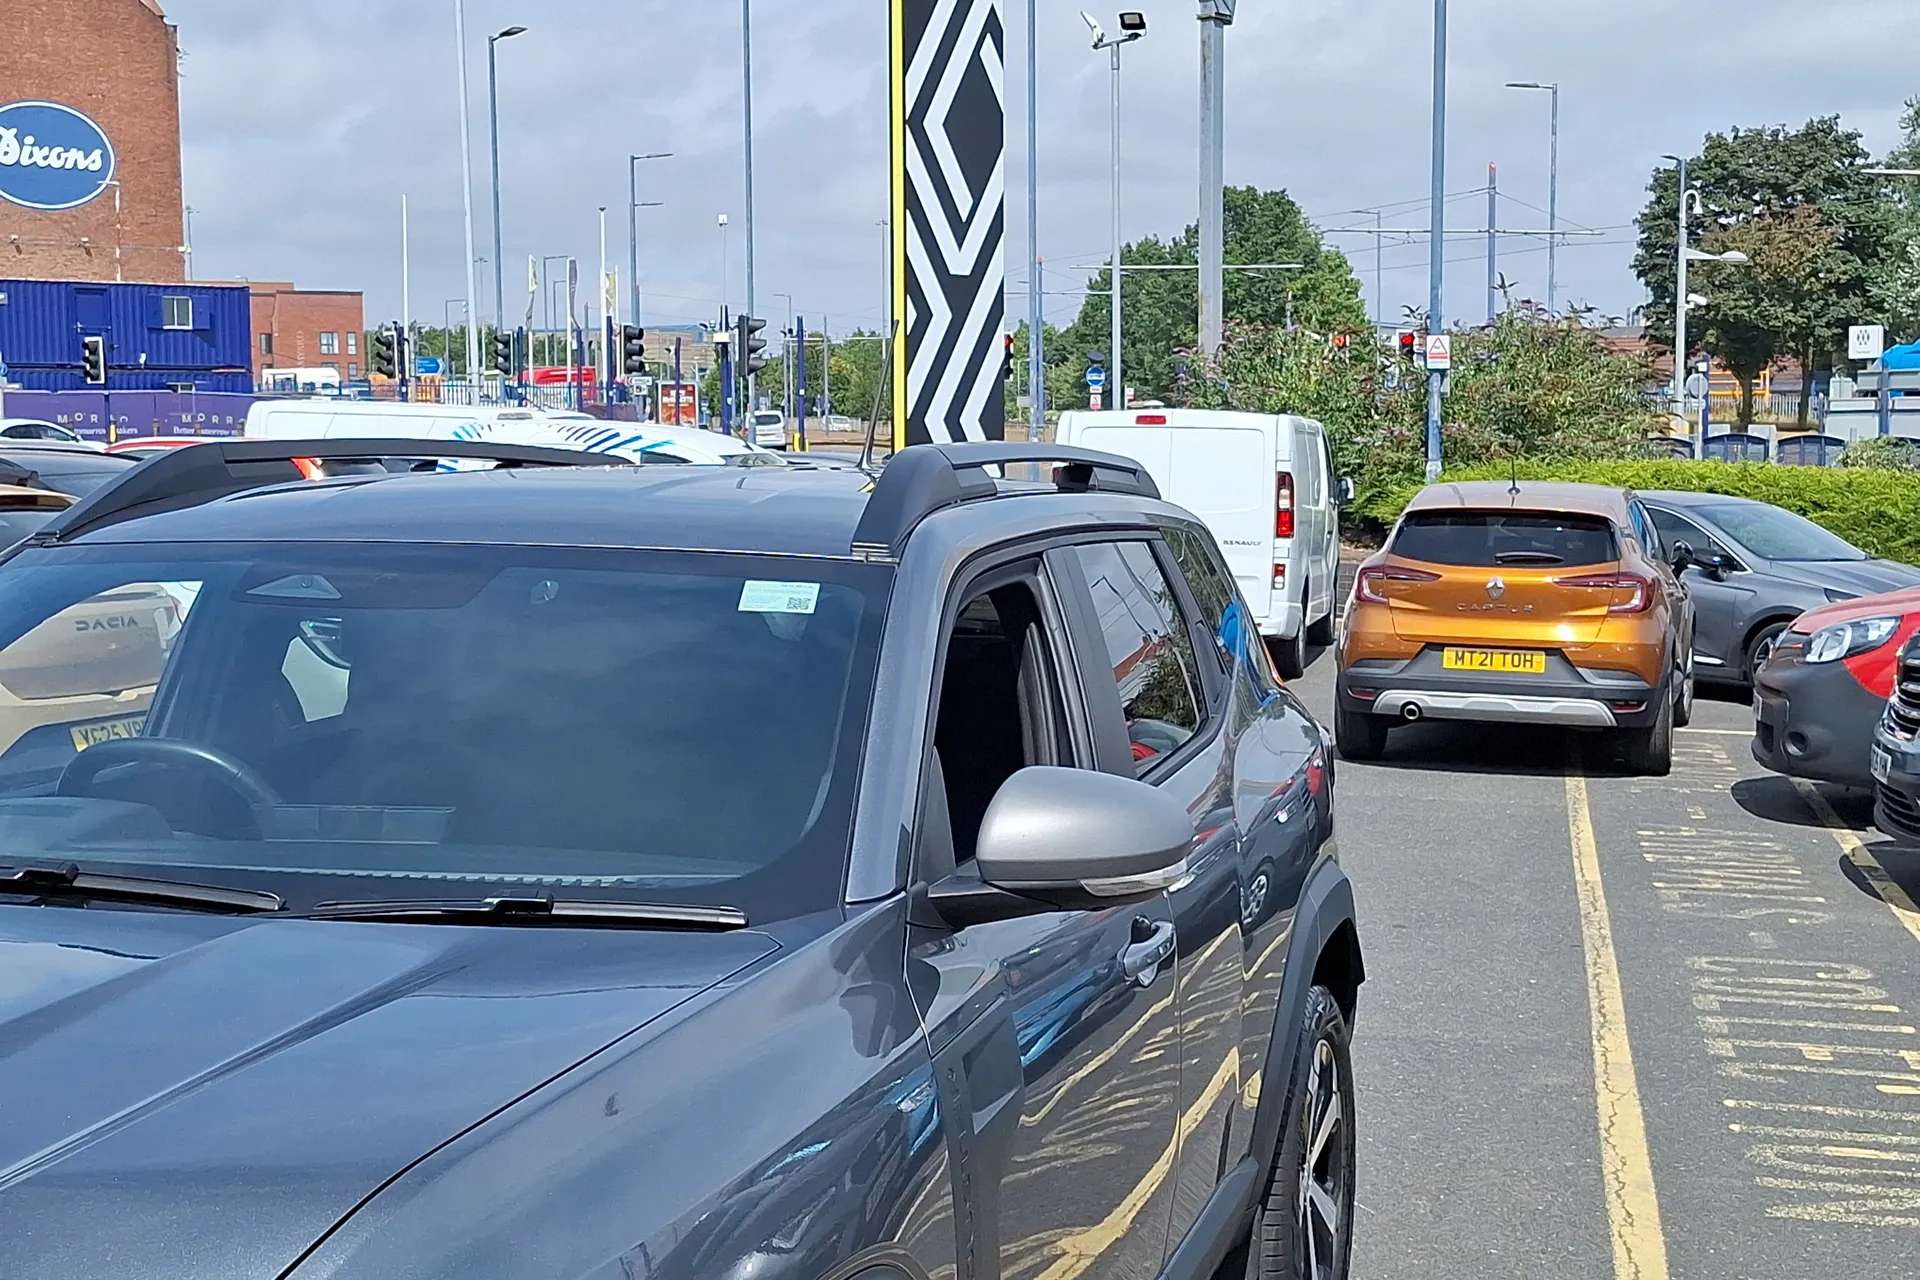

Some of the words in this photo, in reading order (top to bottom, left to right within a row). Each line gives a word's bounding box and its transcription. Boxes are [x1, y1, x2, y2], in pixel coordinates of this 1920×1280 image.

[0, 126, 103, 172] Dixons
[1456, 602, 1534, 615] CAPTUR
[74, 615, 139, 632] DACIA
[1454, 650, 1493, 668] MT21
[1499, 652, 1534, 669] TOH
